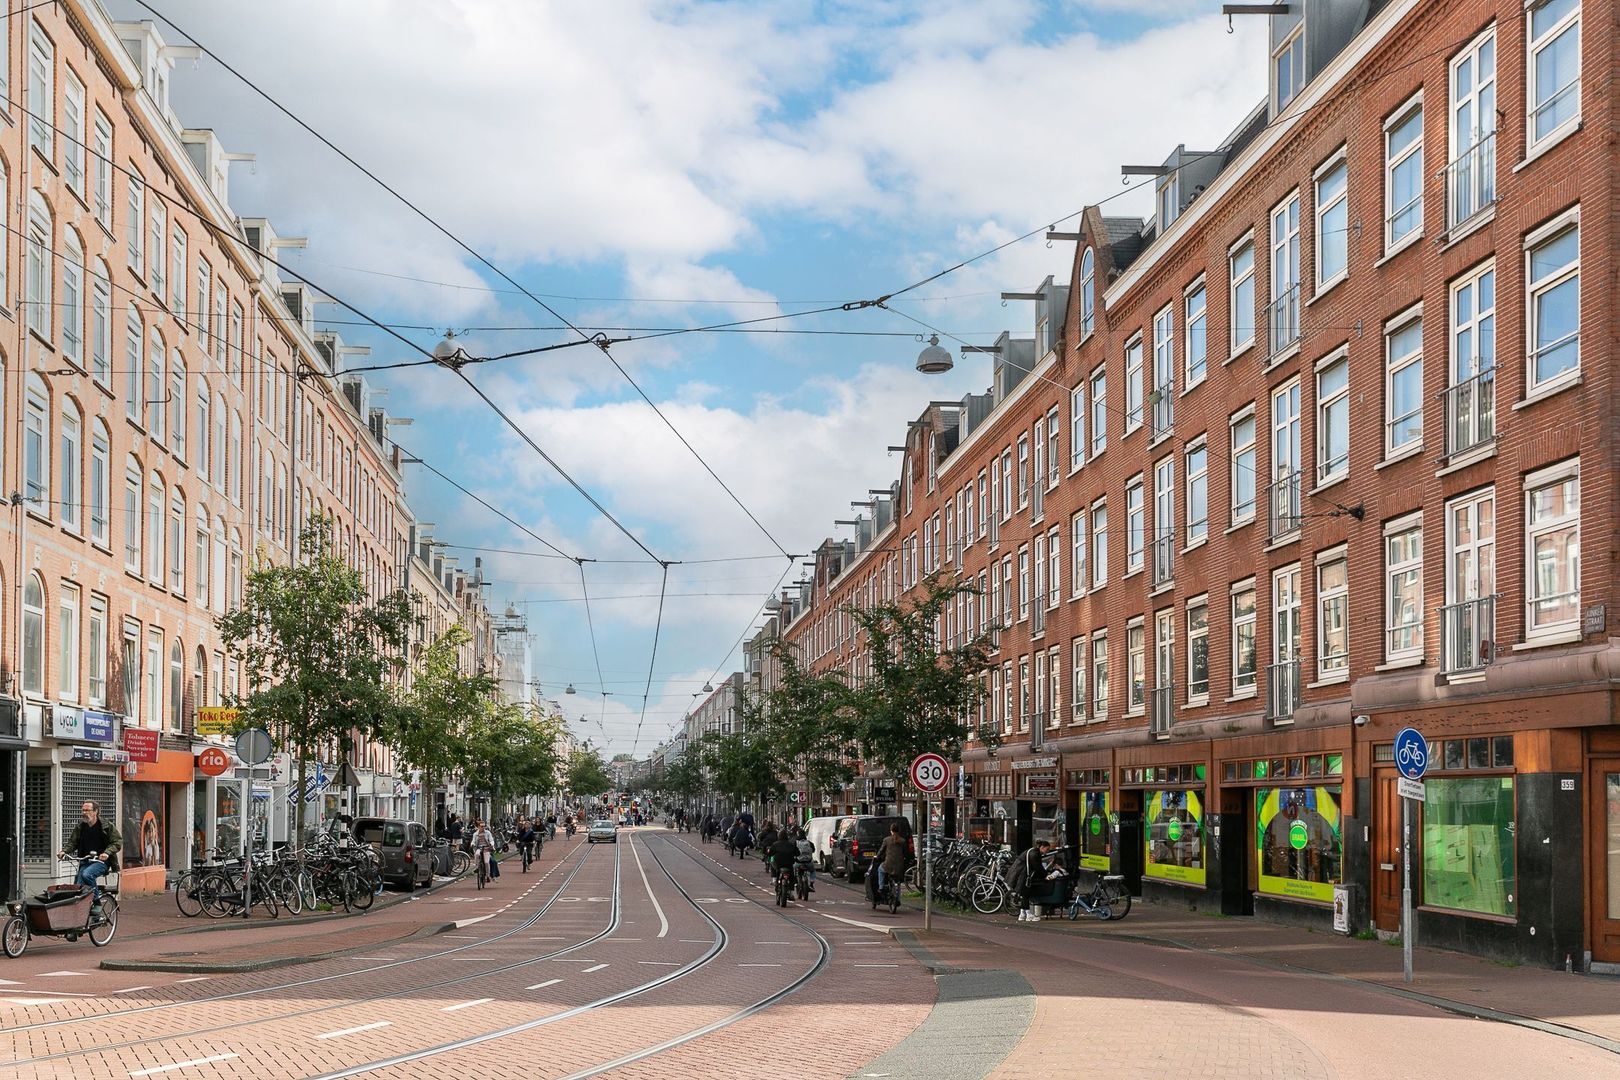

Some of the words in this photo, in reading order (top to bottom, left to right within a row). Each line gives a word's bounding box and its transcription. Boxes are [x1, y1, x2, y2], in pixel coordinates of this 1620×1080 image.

[60, 714, 74, 728] Lyco
[199, 712, 219, 721] Toko
[127, 733, 155, 741] Tobacco
[202, 751, 224, 766] ria
[920, 766, 942, 780] 30
